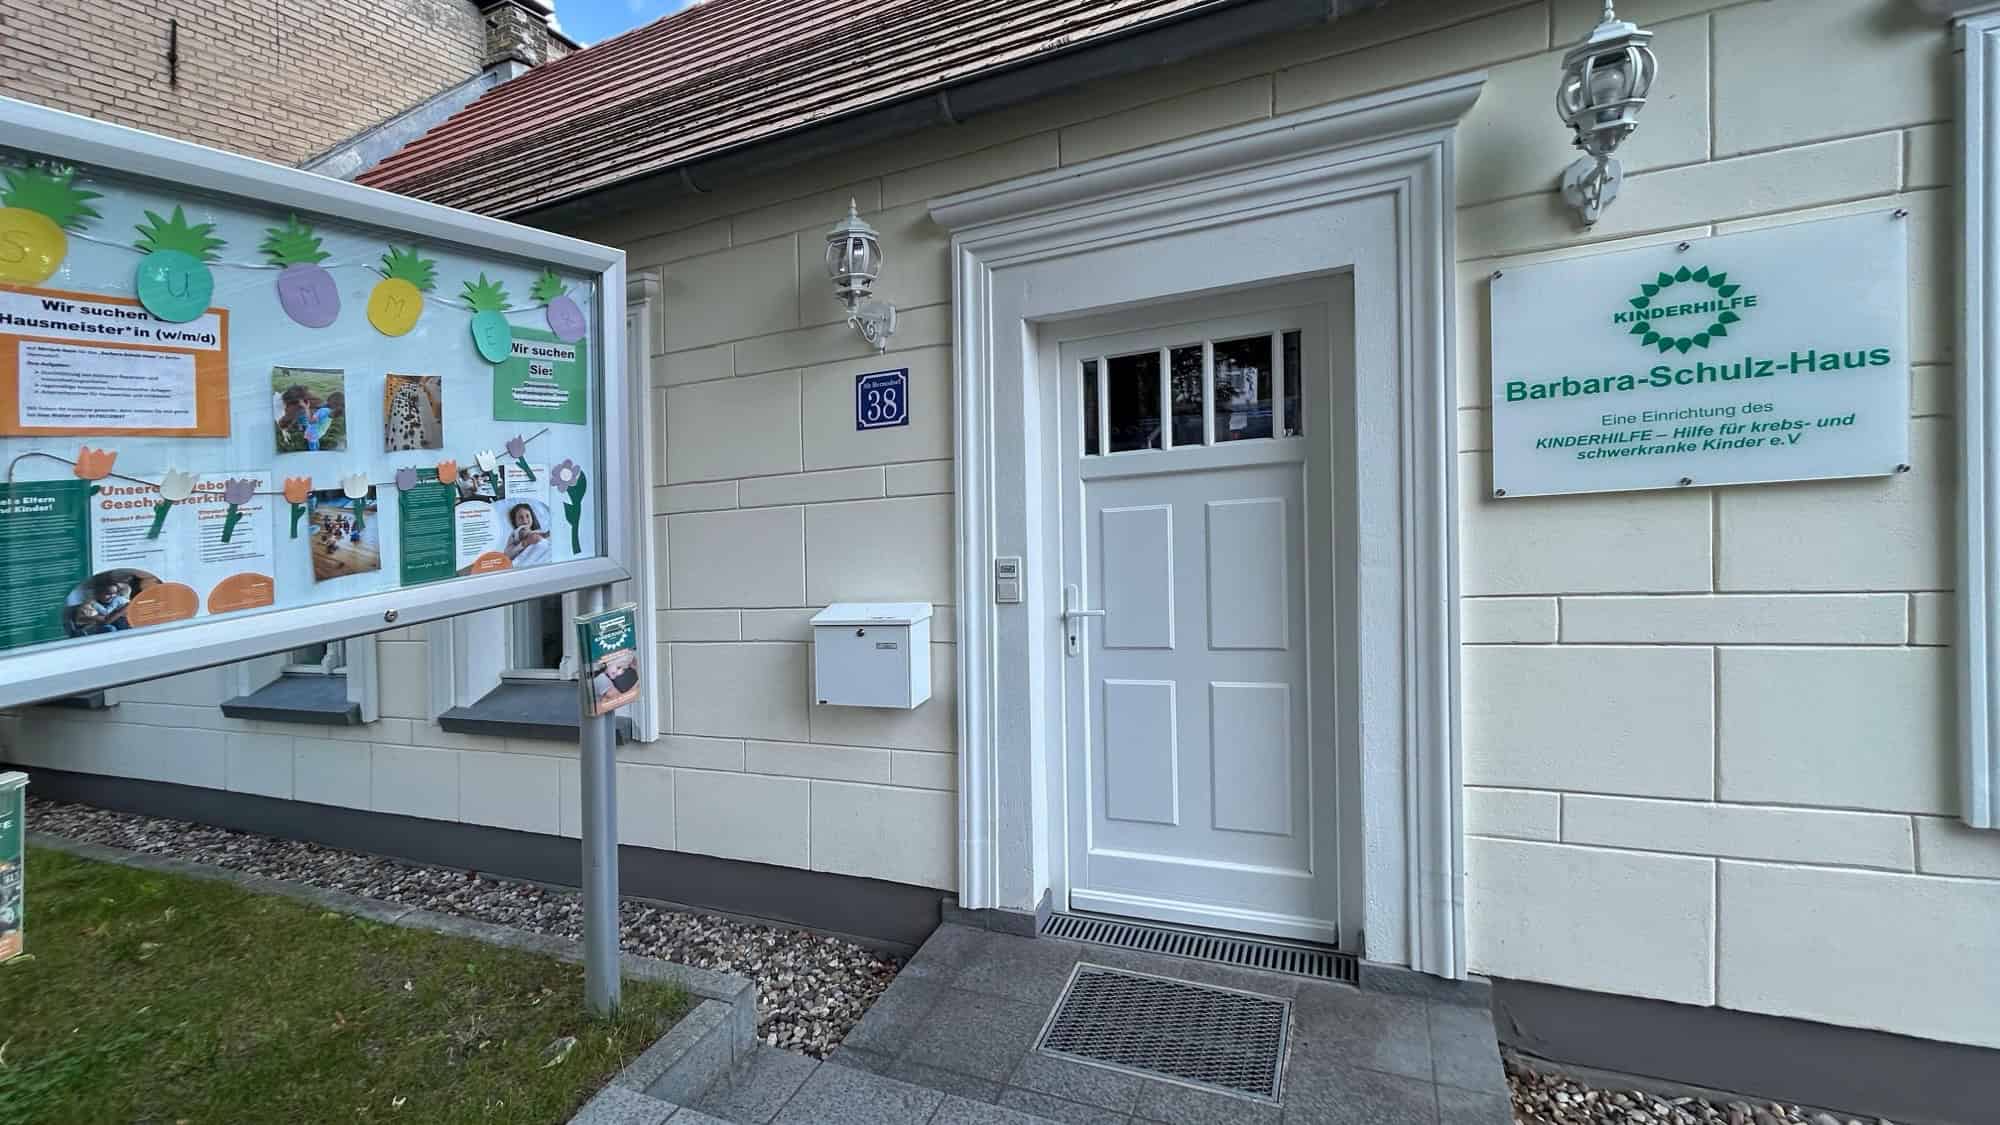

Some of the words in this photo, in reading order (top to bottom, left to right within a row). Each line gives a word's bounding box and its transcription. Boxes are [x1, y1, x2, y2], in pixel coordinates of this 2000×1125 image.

[167, 270, 190, 298] U
[386, 294, 406, 319] M
[41, 299, 75, 313] Wir
[79, 303, 148, 321] suchen
[1613, 295, 1758, 324] KINDERHILFE
[156, 328, 216, 346] (w/m/d)
[532, 345, 575, 359] suchen
[530, 364, 553, 376] Sie:
[1506, 347, 1891, 402] Barbara-Schulz-Haus
[867, 388, 897, 421] 38
[1601, 414, 1637, 426] Eine
[1642, 405, 1737, 423] Einrichtung
[1742, 402, 1774, 415] des
[1536, 429, 1653, 449] KINDERHILFE
[1673, 425, 1714, 439] Hilfe
[1719, 422, 1746, 436] für
[1751, 418, 1812, 433] krebs-
[1816, 413, 1856, 428] und
[1577, 441, 1697, 460] schwerkranke
[1703, 436, 1766, 451] Kinder
